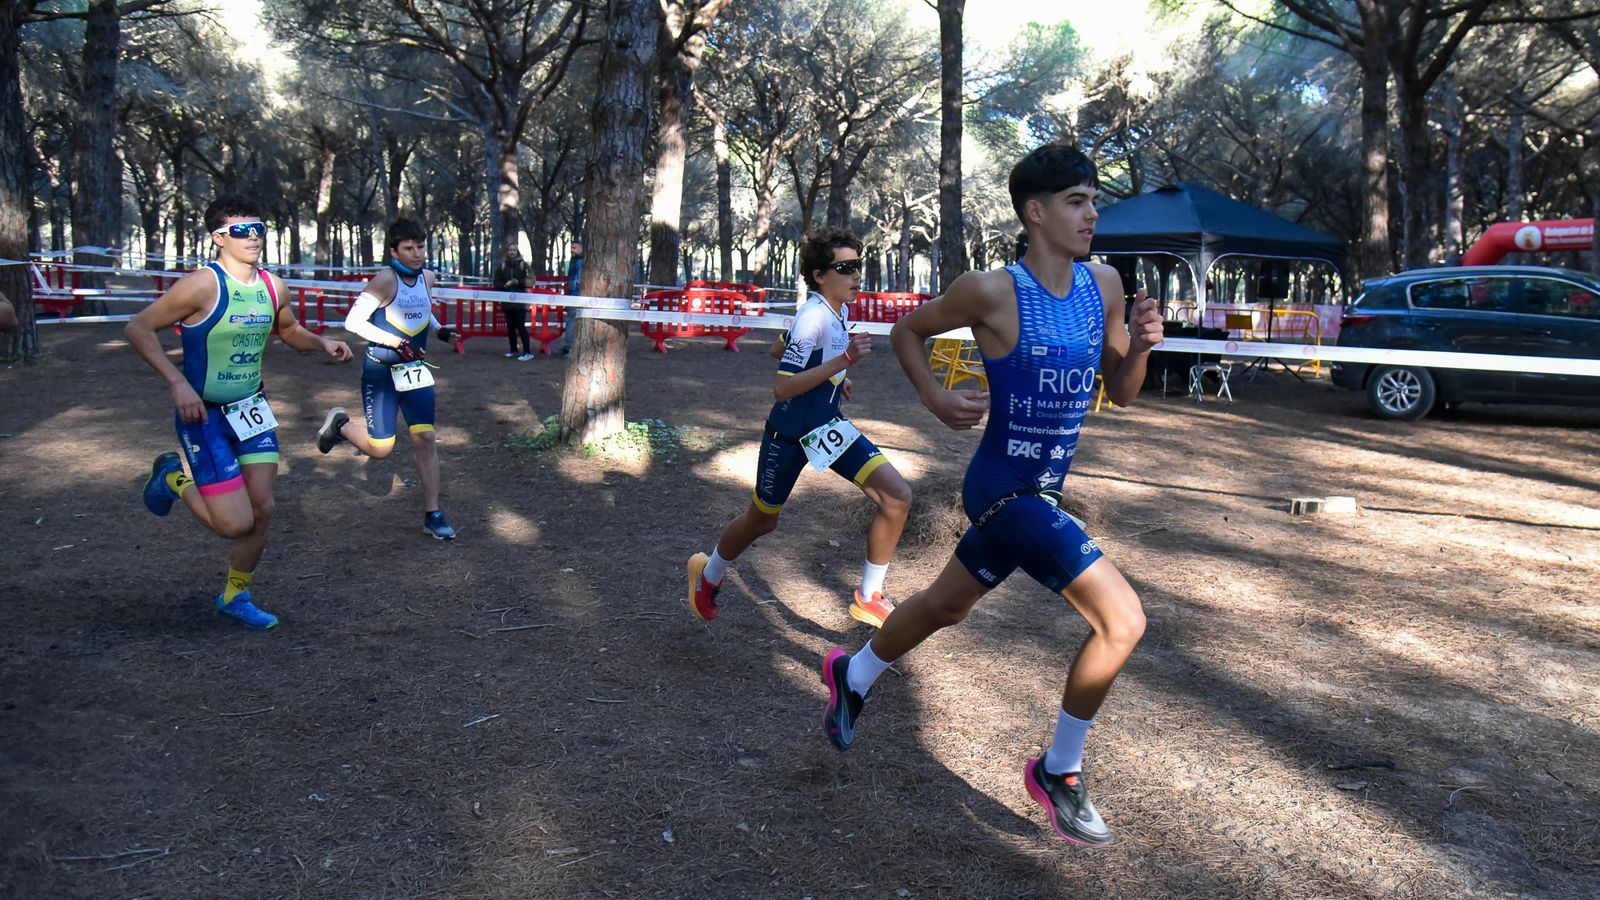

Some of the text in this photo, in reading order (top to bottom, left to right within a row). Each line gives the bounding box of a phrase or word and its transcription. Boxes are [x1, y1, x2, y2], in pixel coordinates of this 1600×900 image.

[403, 312, 423, 320] TORO
[232, 333, 265, 348] CASTRO
[403, 369, 423, 385] 17
[1038, 367, 1095, 394] RICO
[239, 407, 264, 428] 16
[817, 429, 844, 455] 19
